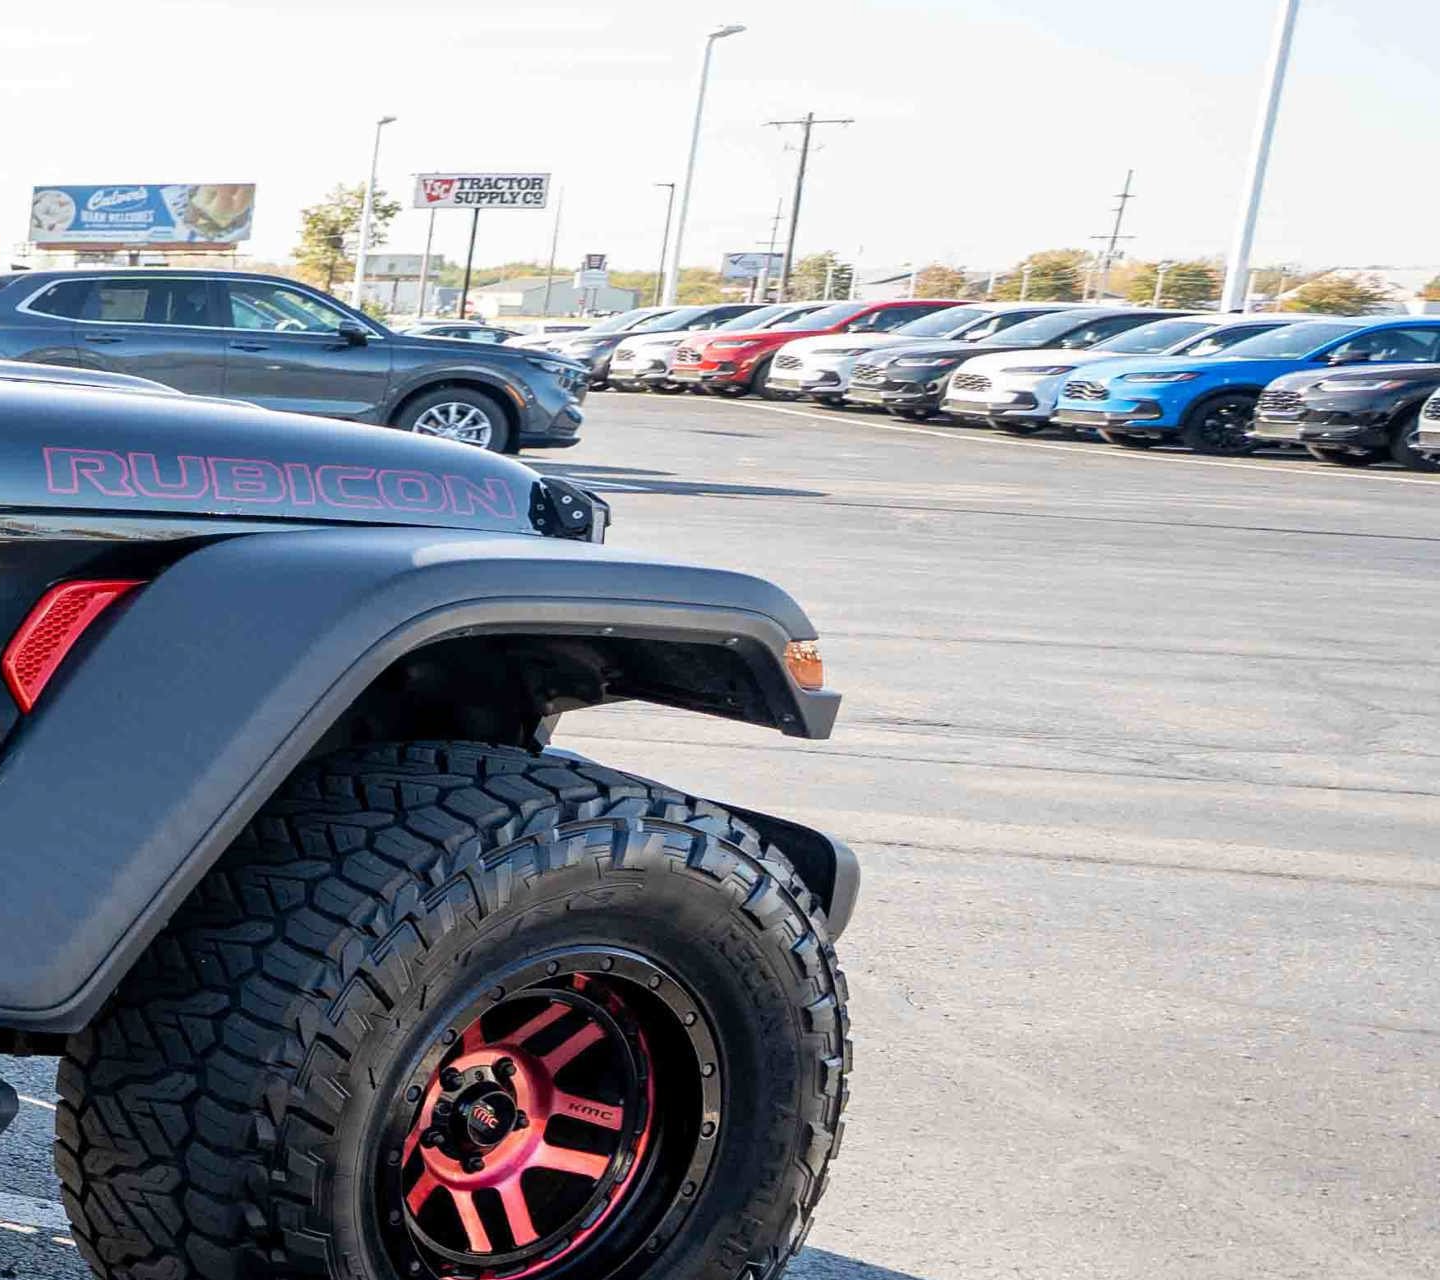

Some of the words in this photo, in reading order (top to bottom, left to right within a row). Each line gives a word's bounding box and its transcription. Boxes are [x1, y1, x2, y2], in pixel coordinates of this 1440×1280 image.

[457, 178, 543, 190] TRACTOR
[454, 191, 520, 204] SUPPLY
[43, 447, 517, 519] RUBICON
[473, 1104, 500, 1129] KMC
[568, 1102, 614, 1121] KMC
